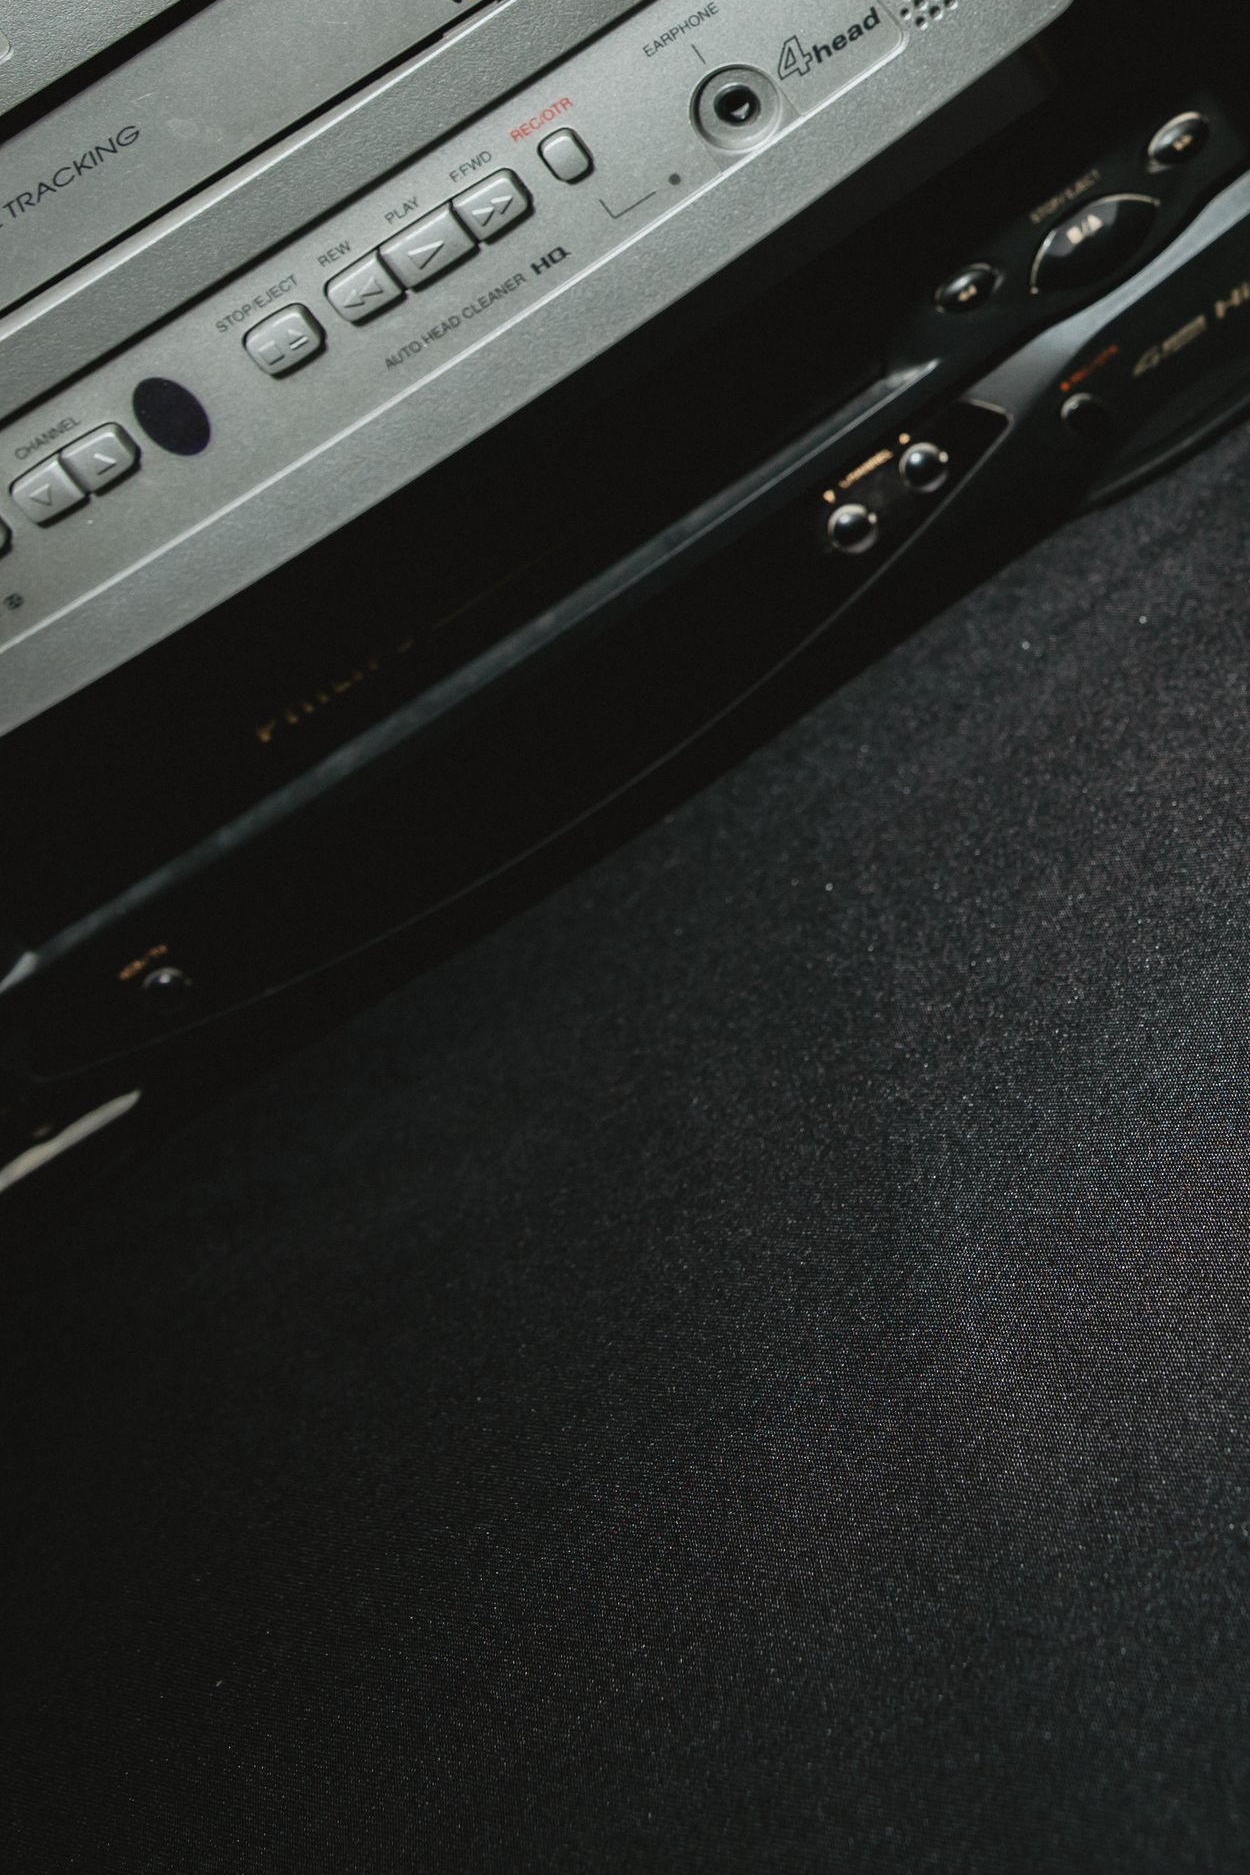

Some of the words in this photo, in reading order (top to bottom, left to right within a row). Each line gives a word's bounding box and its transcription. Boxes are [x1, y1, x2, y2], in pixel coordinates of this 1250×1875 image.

[643, 1, 720, 58] EARPHONE
[508, 97, 574, 143] REC/OTR
[2, 126, 140, 218] TRACKING
[449, 150, 493, 183] F.FWD
[384, 196, 421, 225] PLAY
[317, 240, 352, 268] REW
[215, 274, 299, 334] STOP/EJECT
[384, 340, 424, 370] AUTO
[421, 315, 462, 346] HEAD
[461, 273, 527, 320] CLEANER
[530, 245, 572, 276] HQ
[14, 416, 81, 460] CHANNEL
